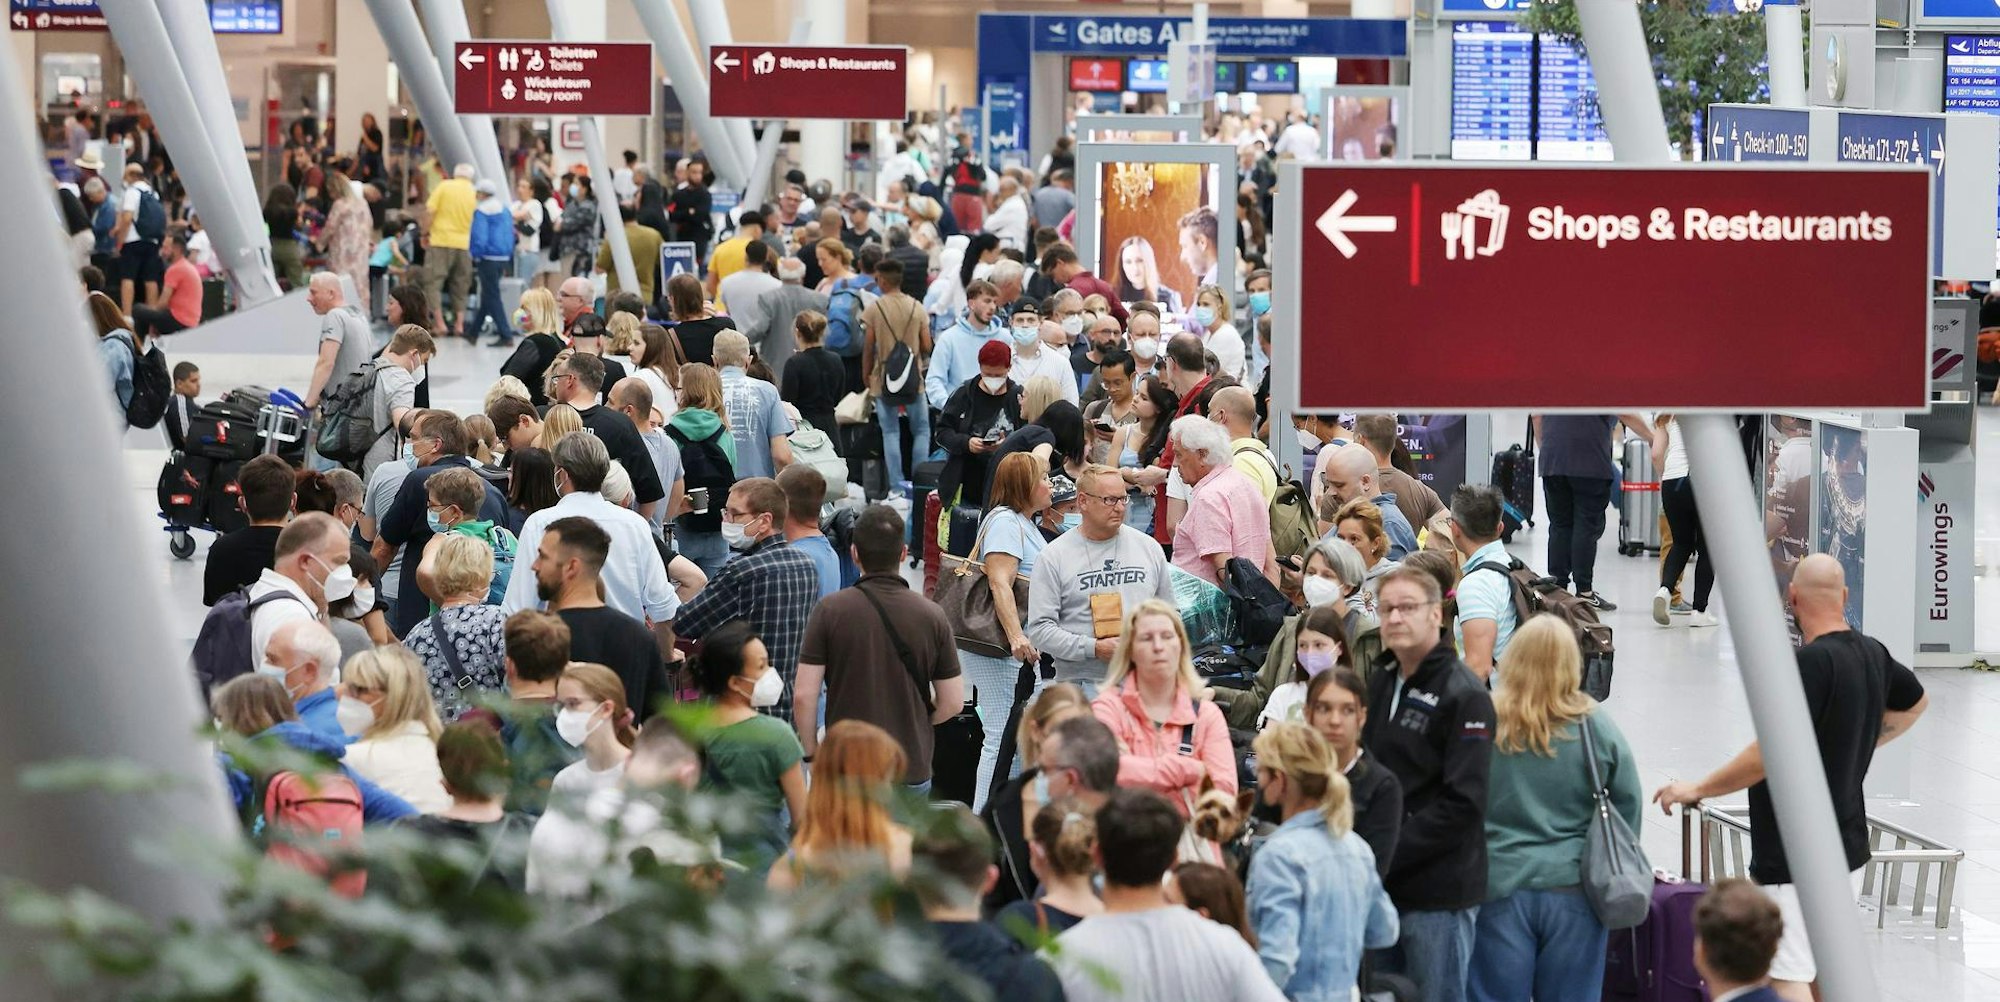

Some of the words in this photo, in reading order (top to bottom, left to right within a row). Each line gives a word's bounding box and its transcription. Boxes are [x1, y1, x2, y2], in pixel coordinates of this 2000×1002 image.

[1077, 20, 1153, 45] Gates
[549, 46, 598, 59] Toiletten
[549, 60, 583, 72] Toilets
[780, 56, 816, 71] Shops
[817, 57, 827, 70] &
[829, 57, 897, 71] Restaurants
[524, 76, 591, 89] Wickelraum
[524, 89, 552, 103] Baby
[554, 91, 583, 102] room
[1744, 131, 1774, 155] Check-in
[1843, 137, 1875, 161] Check-in
[1527, 205, 1641, 249] Shops
[1646, 207, 1677, 242] &
[1683, 208, 1893, 243] Restaurants
[1929, 502, 1953, 621] Eurowings
[1079, 570, 1146, 591] STARTER
